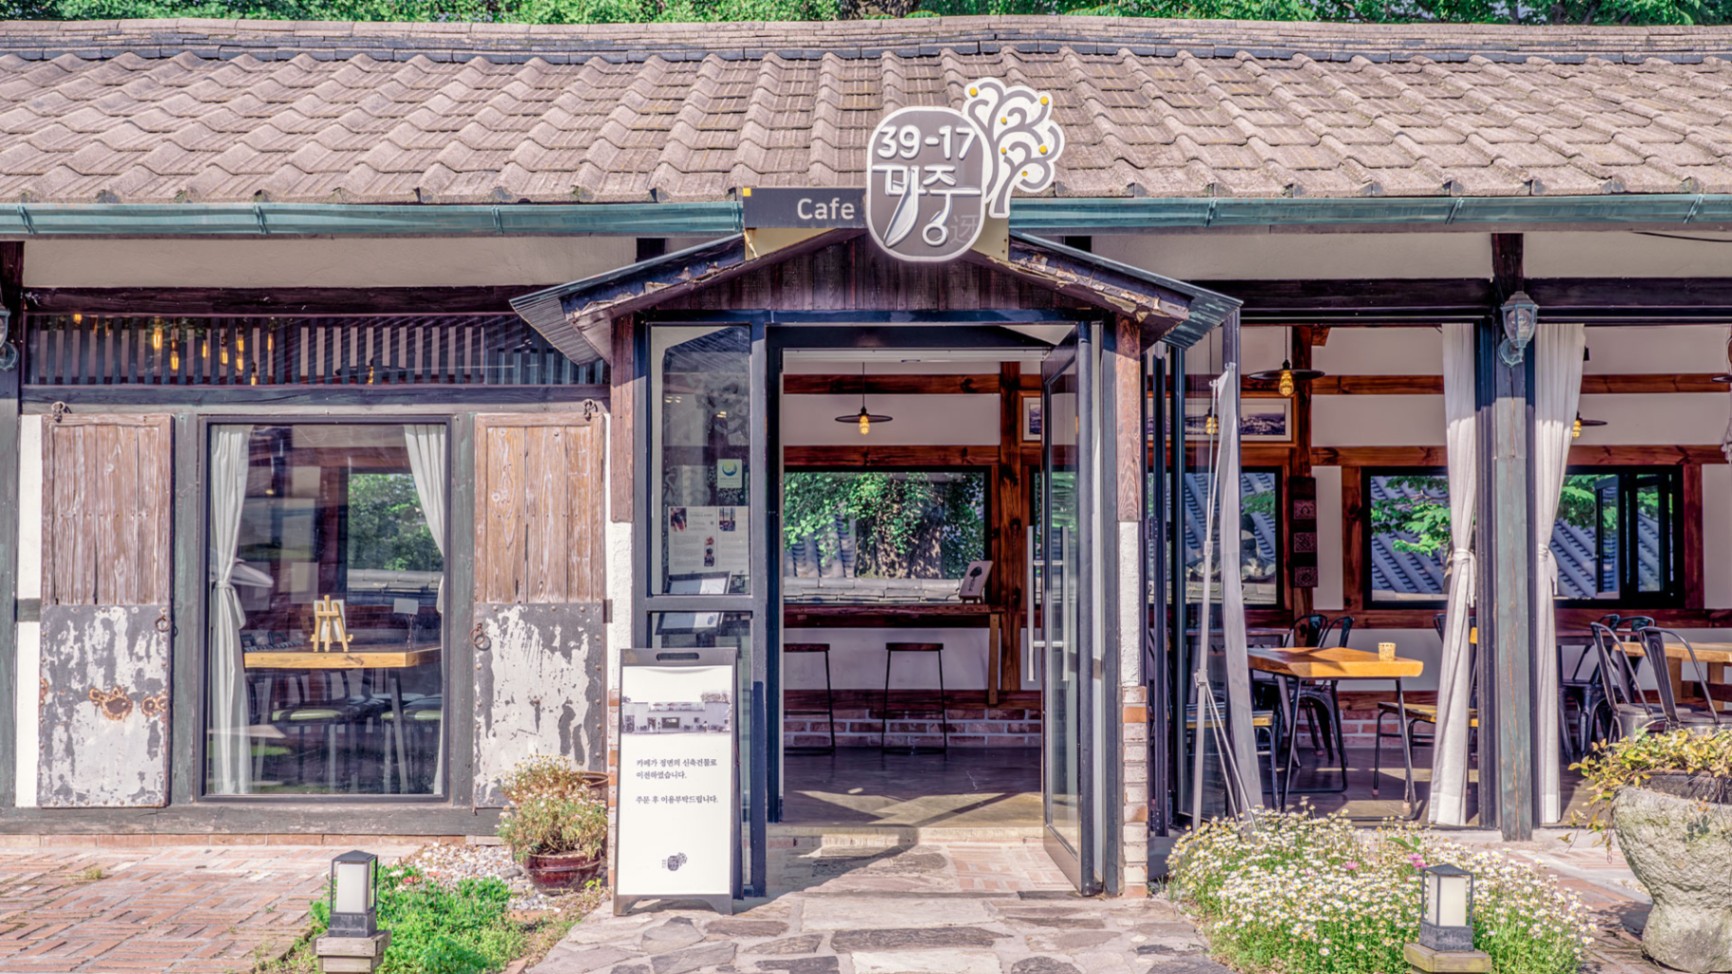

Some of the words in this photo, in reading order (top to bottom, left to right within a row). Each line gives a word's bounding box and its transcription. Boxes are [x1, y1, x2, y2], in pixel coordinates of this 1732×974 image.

[877, 124, 976, 159] 39-17
[797, 197, 855, 220] Cafe
[636, 758, 658, 767] 카페가
[682, 758, 717, 767] 신축건물로
[636, 770, 687, 780] 이전하였습니다.
[636, 795, 650, 804] 주문
[652, 795, 659, 804] 후
[661, 795, 718, 804] 이용부탁드립니다.
